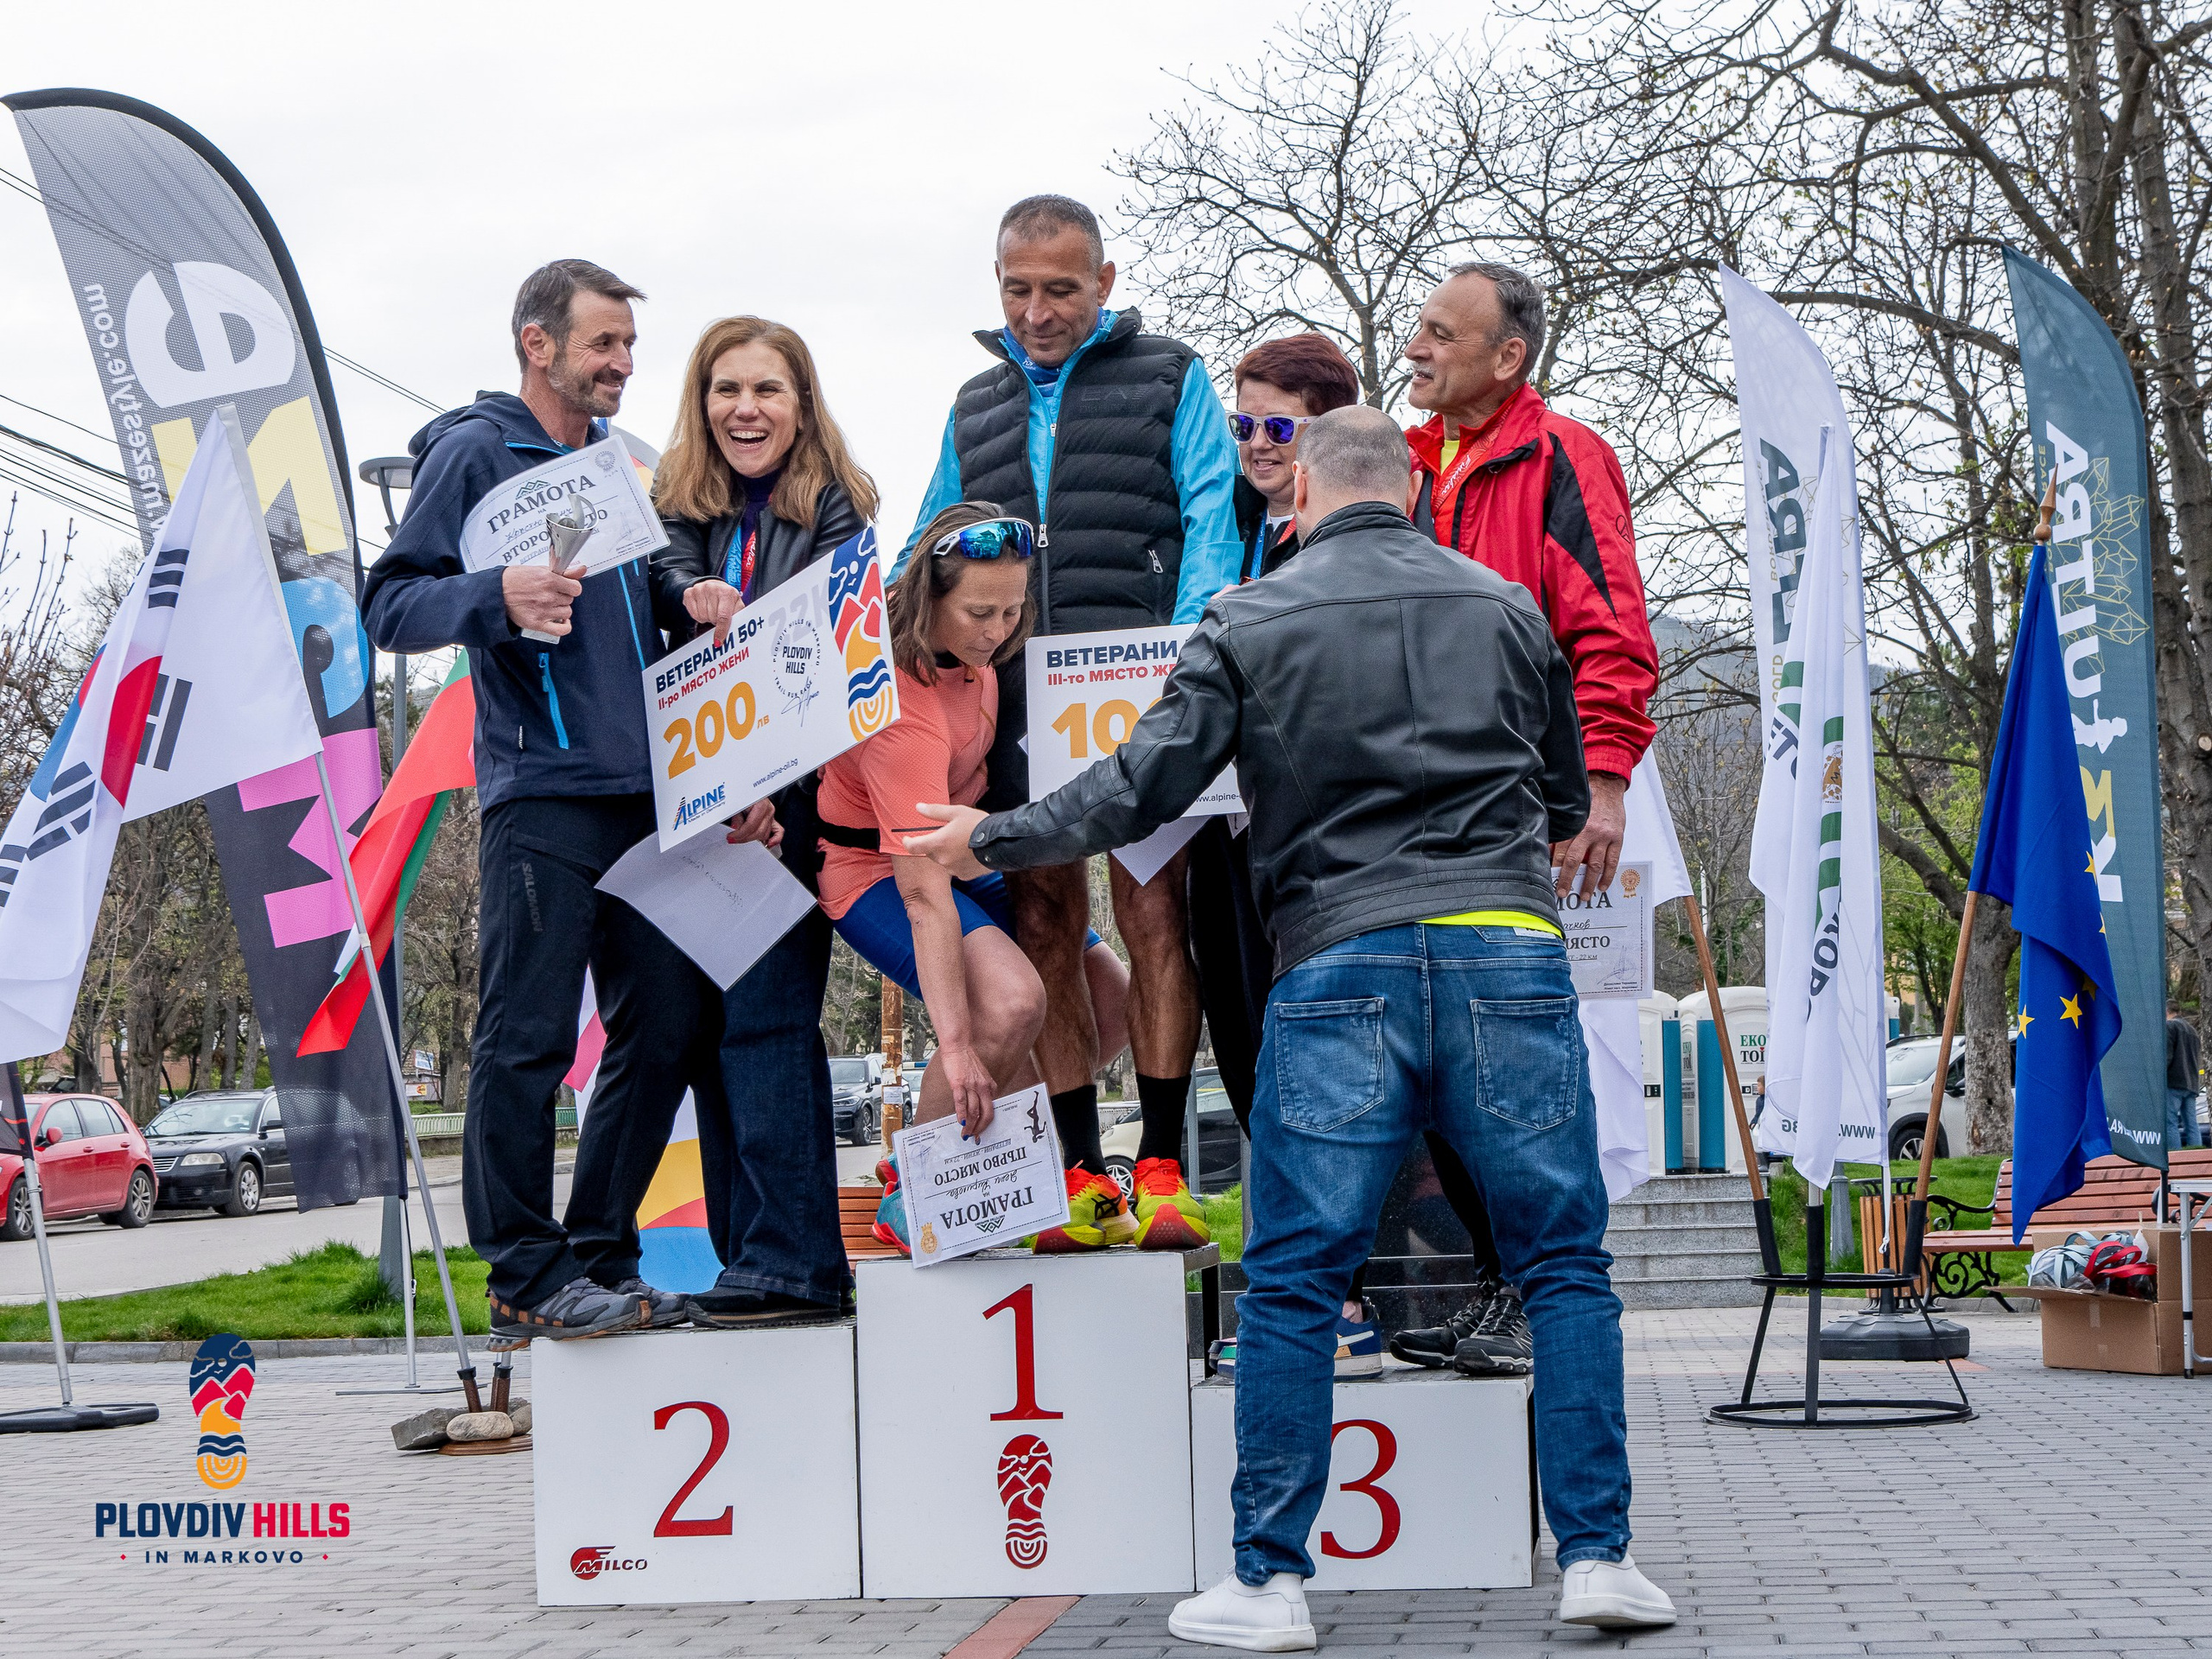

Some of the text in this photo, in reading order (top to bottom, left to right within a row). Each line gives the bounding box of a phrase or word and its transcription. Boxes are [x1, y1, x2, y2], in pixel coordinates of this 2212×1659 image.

[486, 475, 596, 534] ГРАМОТА
[502, 530, 551, 564] ВТОРО
[656, 616, 765, 695] ВЕТЕРАНИ 50+
[681, 666, 717, 697] МЯСТО
[718, 646, 750, 673] ЖЕНИ
[782, 645, 812, 660] PLOVDIV
[785, 661, 805, 674] HILLS
[1046, 640, 1178, 669] ВЕТЕРАНИ
[1089, 666, 1148, 683] МЯСТО
[664, 681, 756, 780] 200
[1051, 696, 1163, 759] 10
[753, 758, 798, 788] www.alpine-oil.bg
[673, 785, 726, 831] ALPINE
[522, 862, 543, 932] SALOMON
[934, 1147, 1027, 1186] ПЪРВО МЯСТО
[940, 1185, 1034, 1230] ГРАМОТА
[982, 1283, 1064, 1421] 1
[654, 1401, 733, 1538] 2
[1320, 1419, 1402, 1560] 3
[574, 1559, 648, 1574] MILCO
